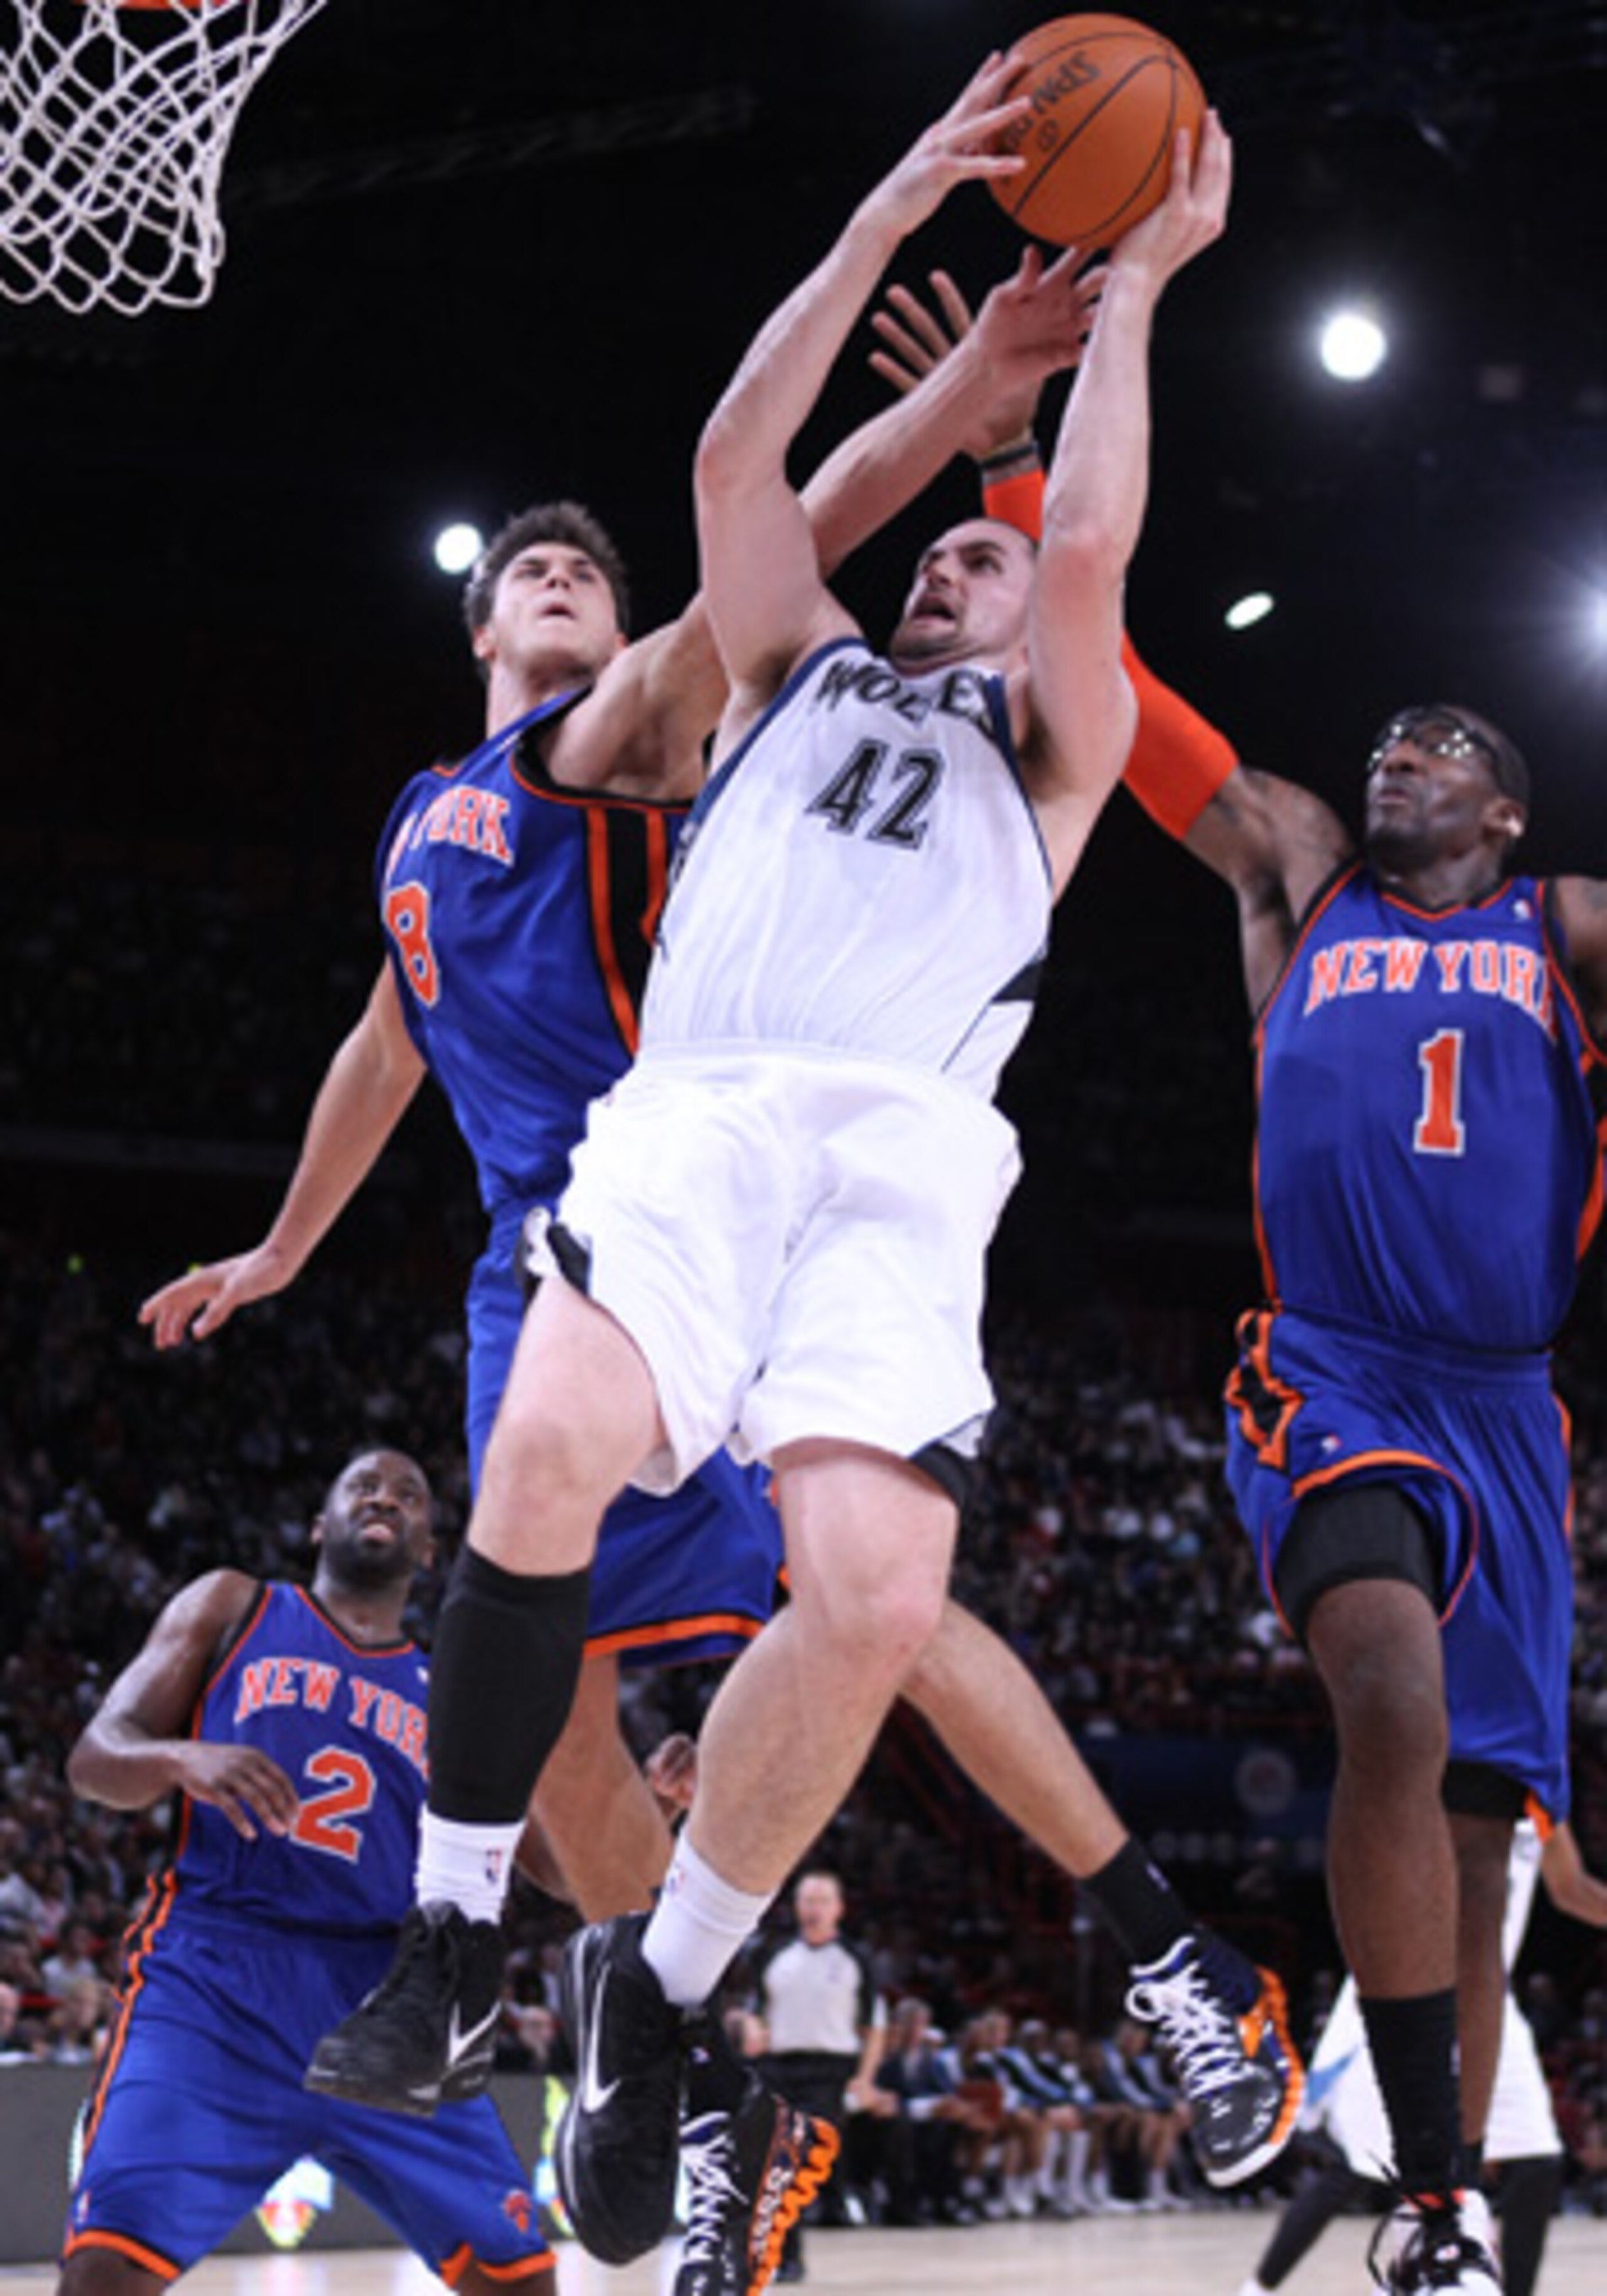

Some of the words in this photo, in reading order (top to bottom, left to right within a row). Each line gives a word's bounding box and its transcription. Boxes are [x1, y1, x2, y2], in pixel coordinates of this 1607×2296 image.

[804, 738, 944, 851] 42
[381, 881, 441, 1009] 8
[1303, 937, 1429, 1017] NEW
[1413, 1028, 1466, 1156] 1
[234, 1656, 340, 1725] NEW
[348, 1677, 429, 1782] YOR
[289, 1745, 376, 1863] 2
